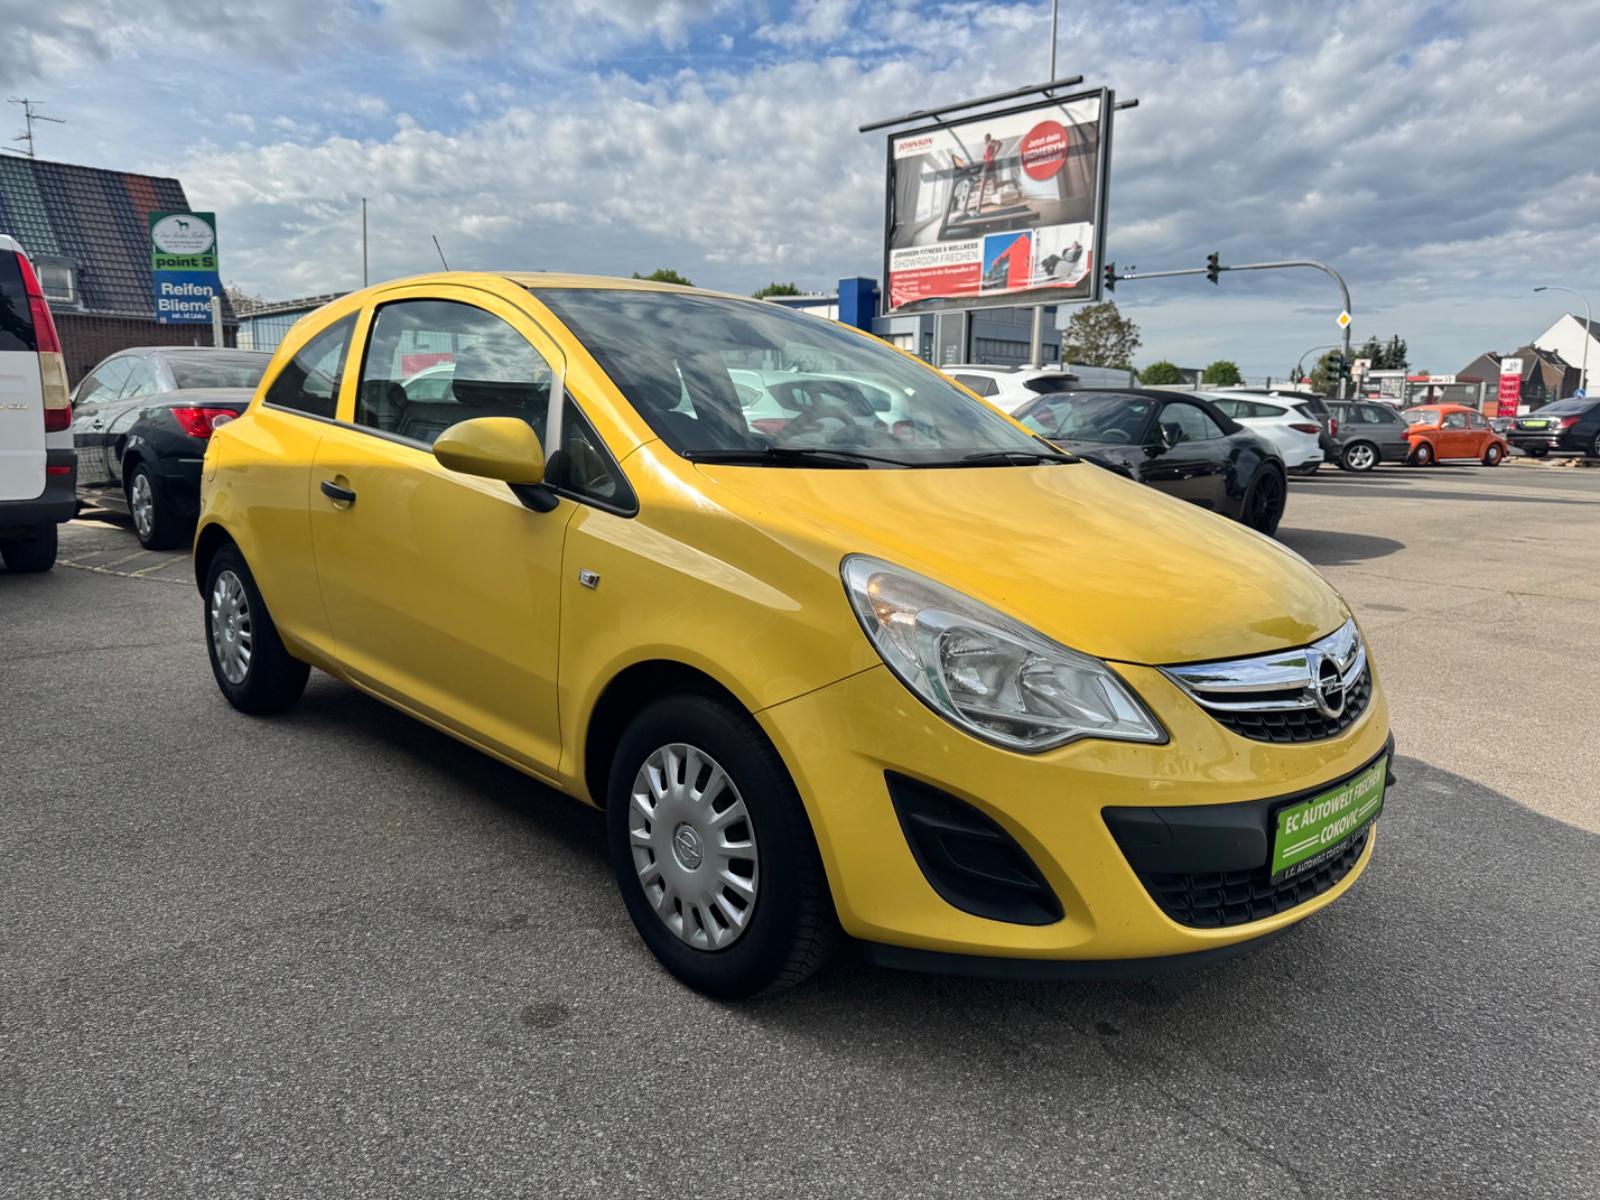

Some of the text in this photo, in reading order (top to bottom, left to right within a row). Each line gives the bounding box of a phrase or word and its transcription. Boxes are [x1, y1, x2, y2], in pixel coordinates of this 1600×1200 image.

[156, 256, 214, 269] point S
[895, 250, 979, 268] SHOWROOM FRECHEN
[160, 282, 213, 296] Reifen
[158, 298, 213, 312] Blieme
[1285, 812, 1300, 834] EC
[1301, 789, 1355, 829] AUTOWELT
[1354, 769, 1381, 801] FRECHEN
[1320, 808, 1359, 844] COKOVIC
